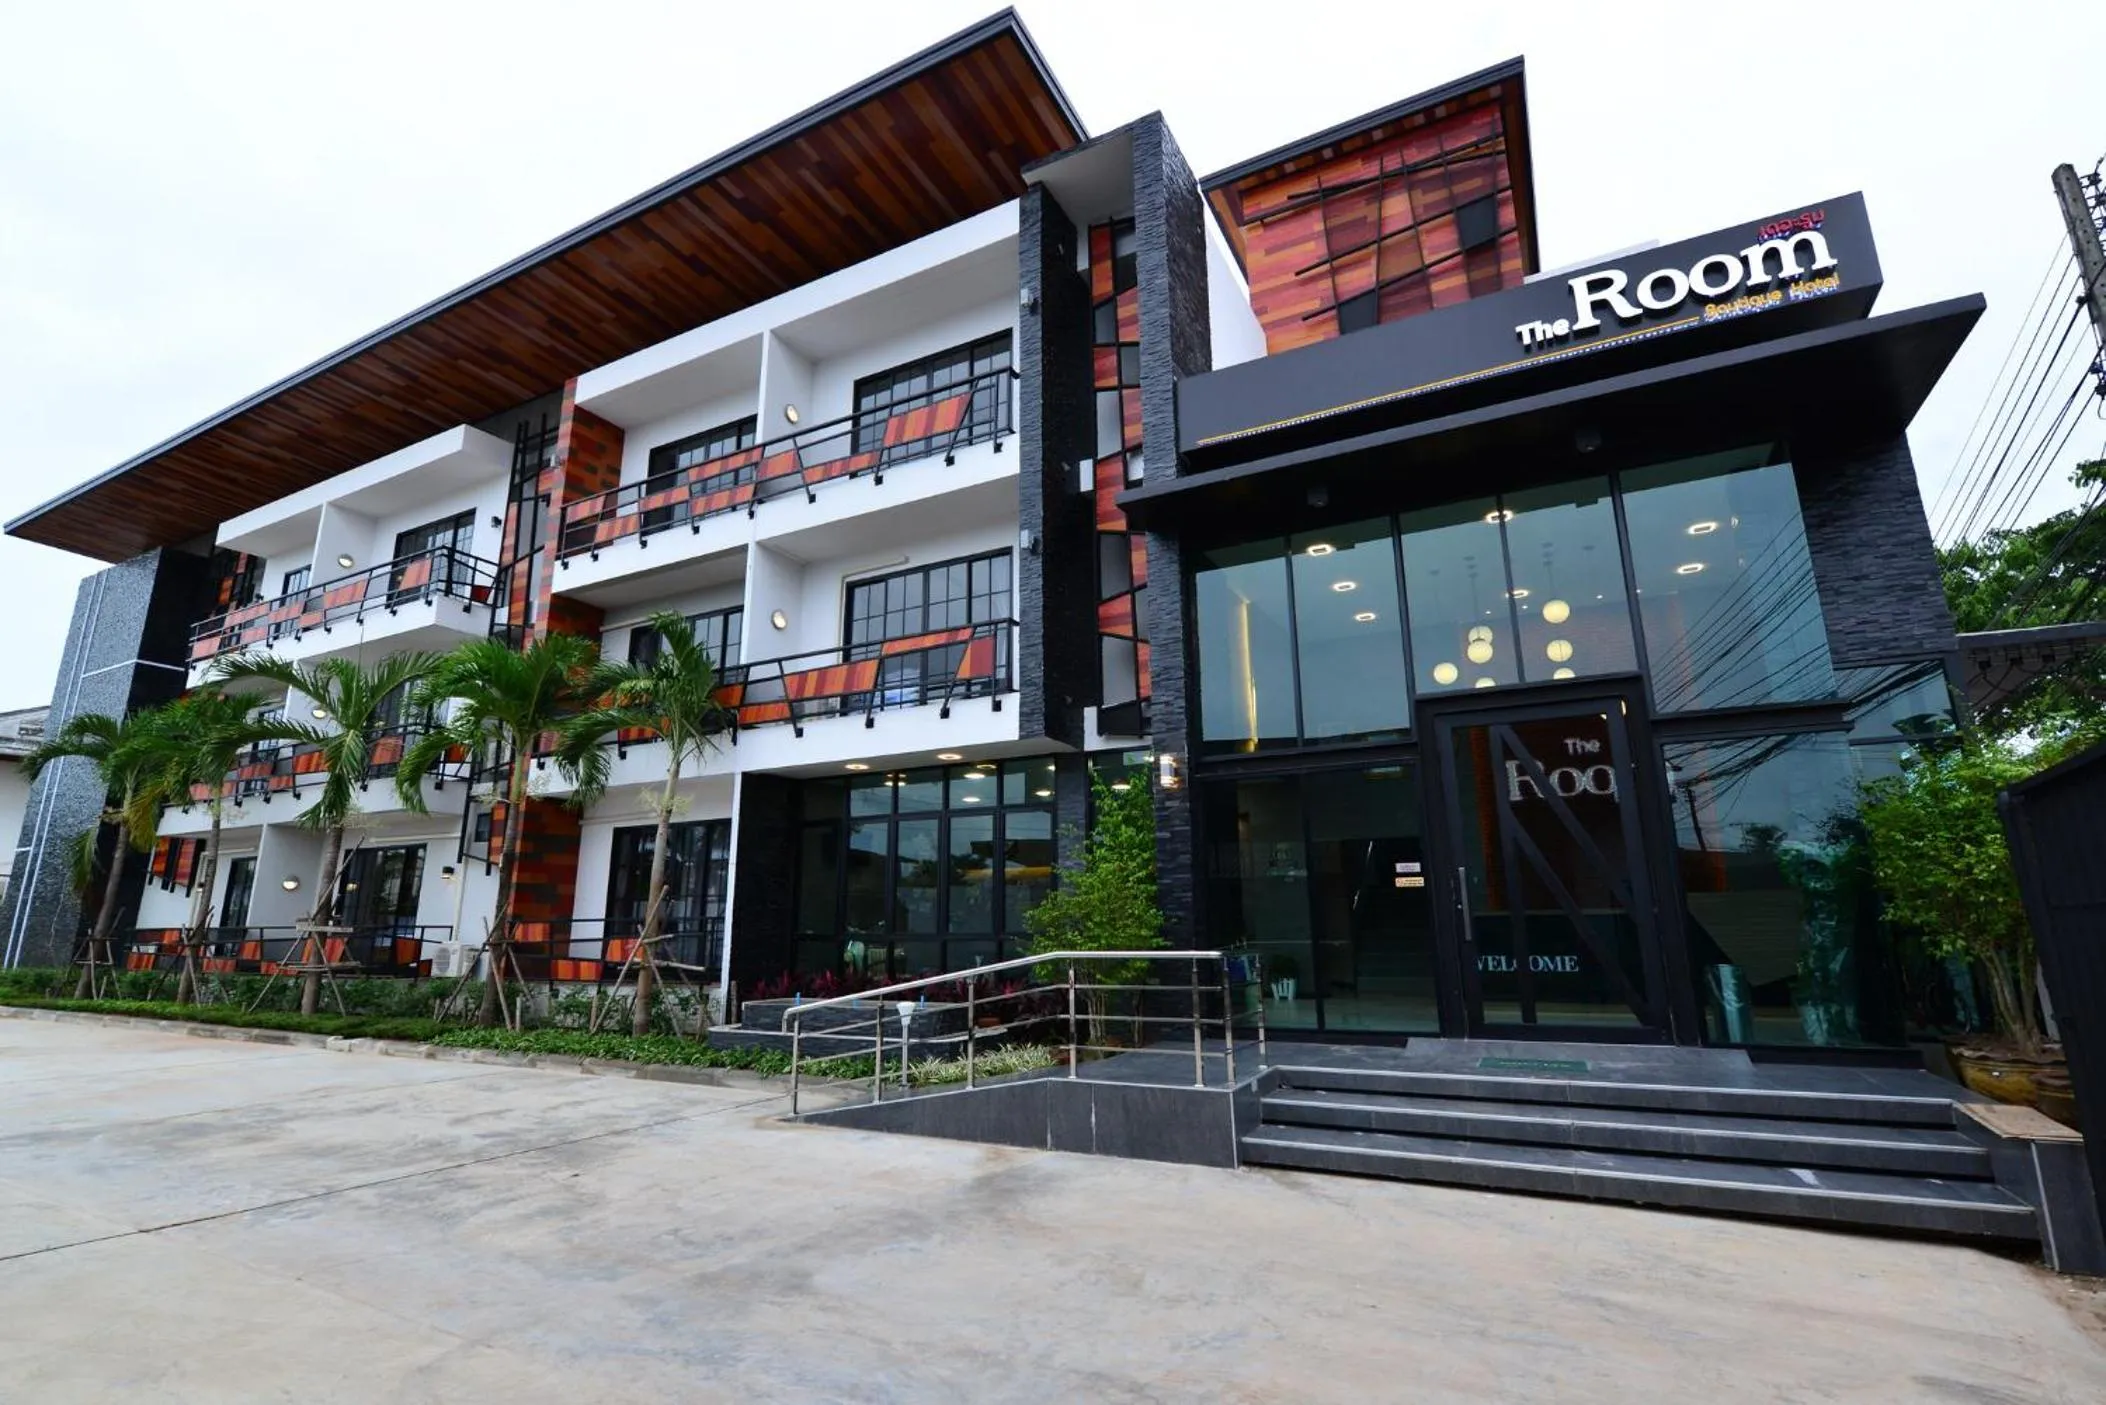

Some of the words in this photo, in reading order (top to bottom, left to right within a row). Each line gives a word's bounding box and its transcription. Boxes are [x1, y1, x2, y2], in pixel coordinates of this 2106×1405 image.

[1515, 318, 1570, 345] The
[1568, 229, 1838, 331] Room
[1704, 290, 1782, 317] Boutique
[1790, 272, 1840, 296] Hotel
[1563, 738, 1601, 756] The
[1505, 759, 1620, 803] Roo
[1477, 954, 1579, 972] ELOME
